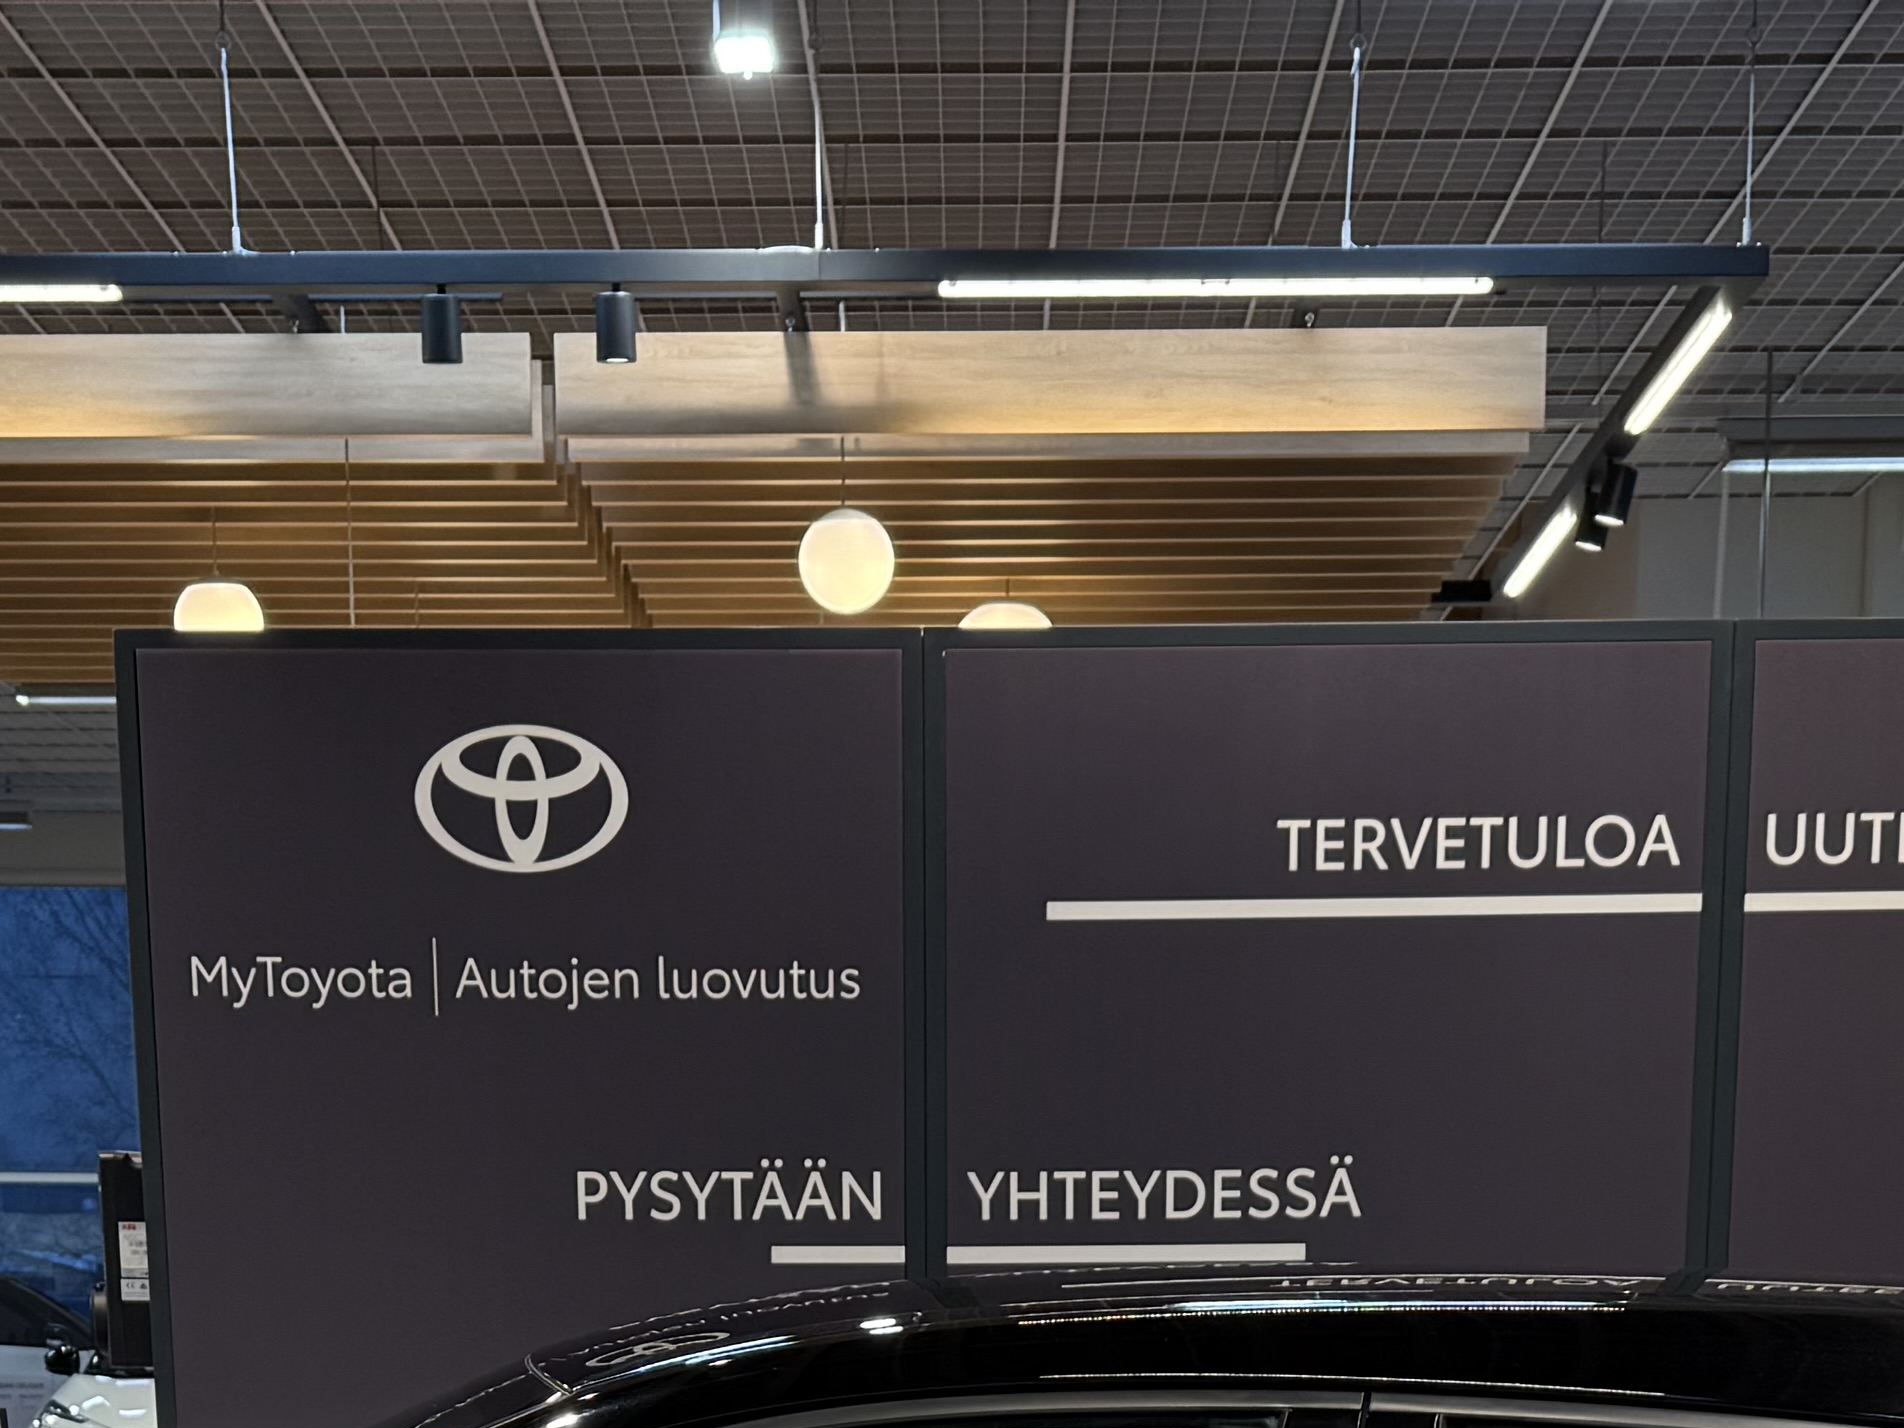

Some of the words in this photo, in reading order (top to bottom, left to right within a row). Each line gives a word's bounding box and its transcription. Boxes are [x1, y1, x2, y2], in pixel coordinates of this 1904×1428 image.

[1277, 814, 1681, 871] TERVETULOA
[190, 955, 412, 1009] MyToyota
[455, 957, 639, 1010] Autojen
[658, 955, 860, 1000] luovutus
[577, 1158, 882, 1221] PYSYTÄÄN
[967, 1155, 1362, 1221] YHTEYDESSÄ
